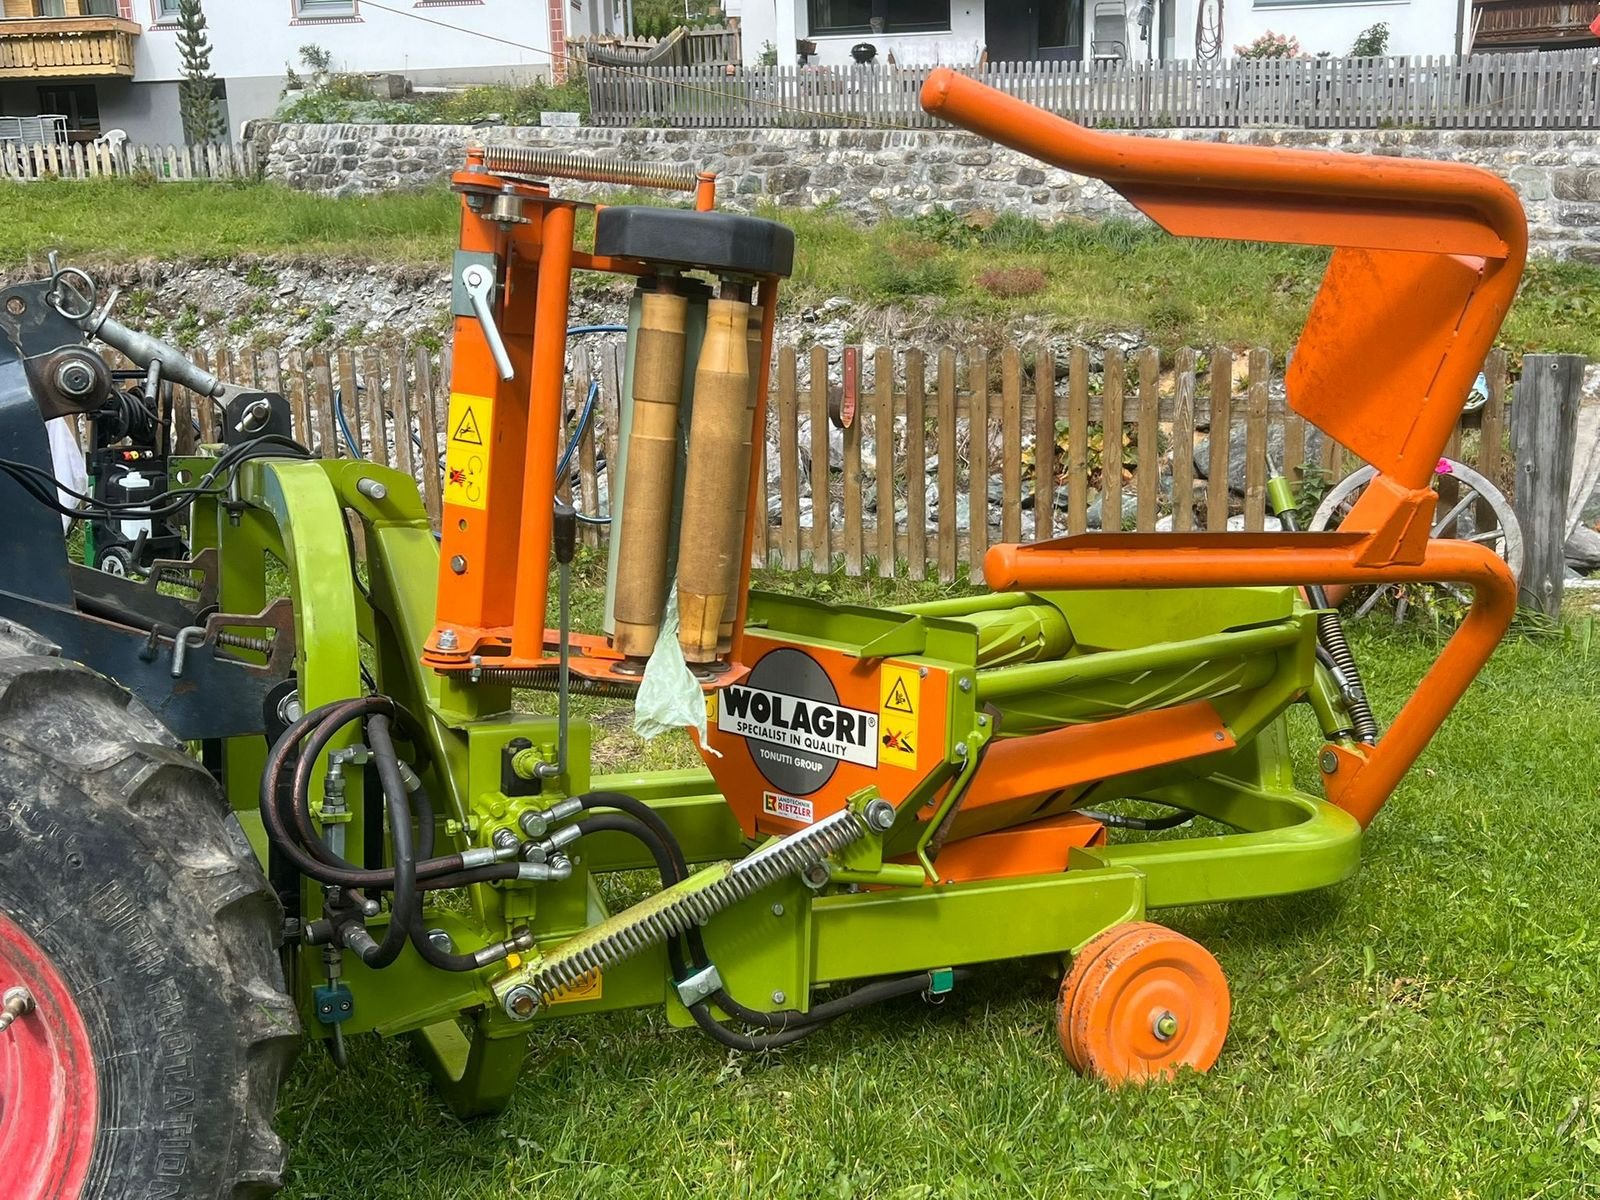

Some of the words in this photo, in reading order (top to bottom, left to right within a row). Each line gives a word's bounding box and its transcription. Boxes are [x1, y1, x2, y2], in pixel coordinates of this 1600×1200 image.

[737, 721, 787, 742] SPECIALIST
[790, 733, 801, 746] IN
[804, 737, 847, 757] QUALITY
[759, 748, 793, 766] TONUTTI
[794, 756, 823, 773] GROUP
[777, 802, 812, 818] RIETZLER
